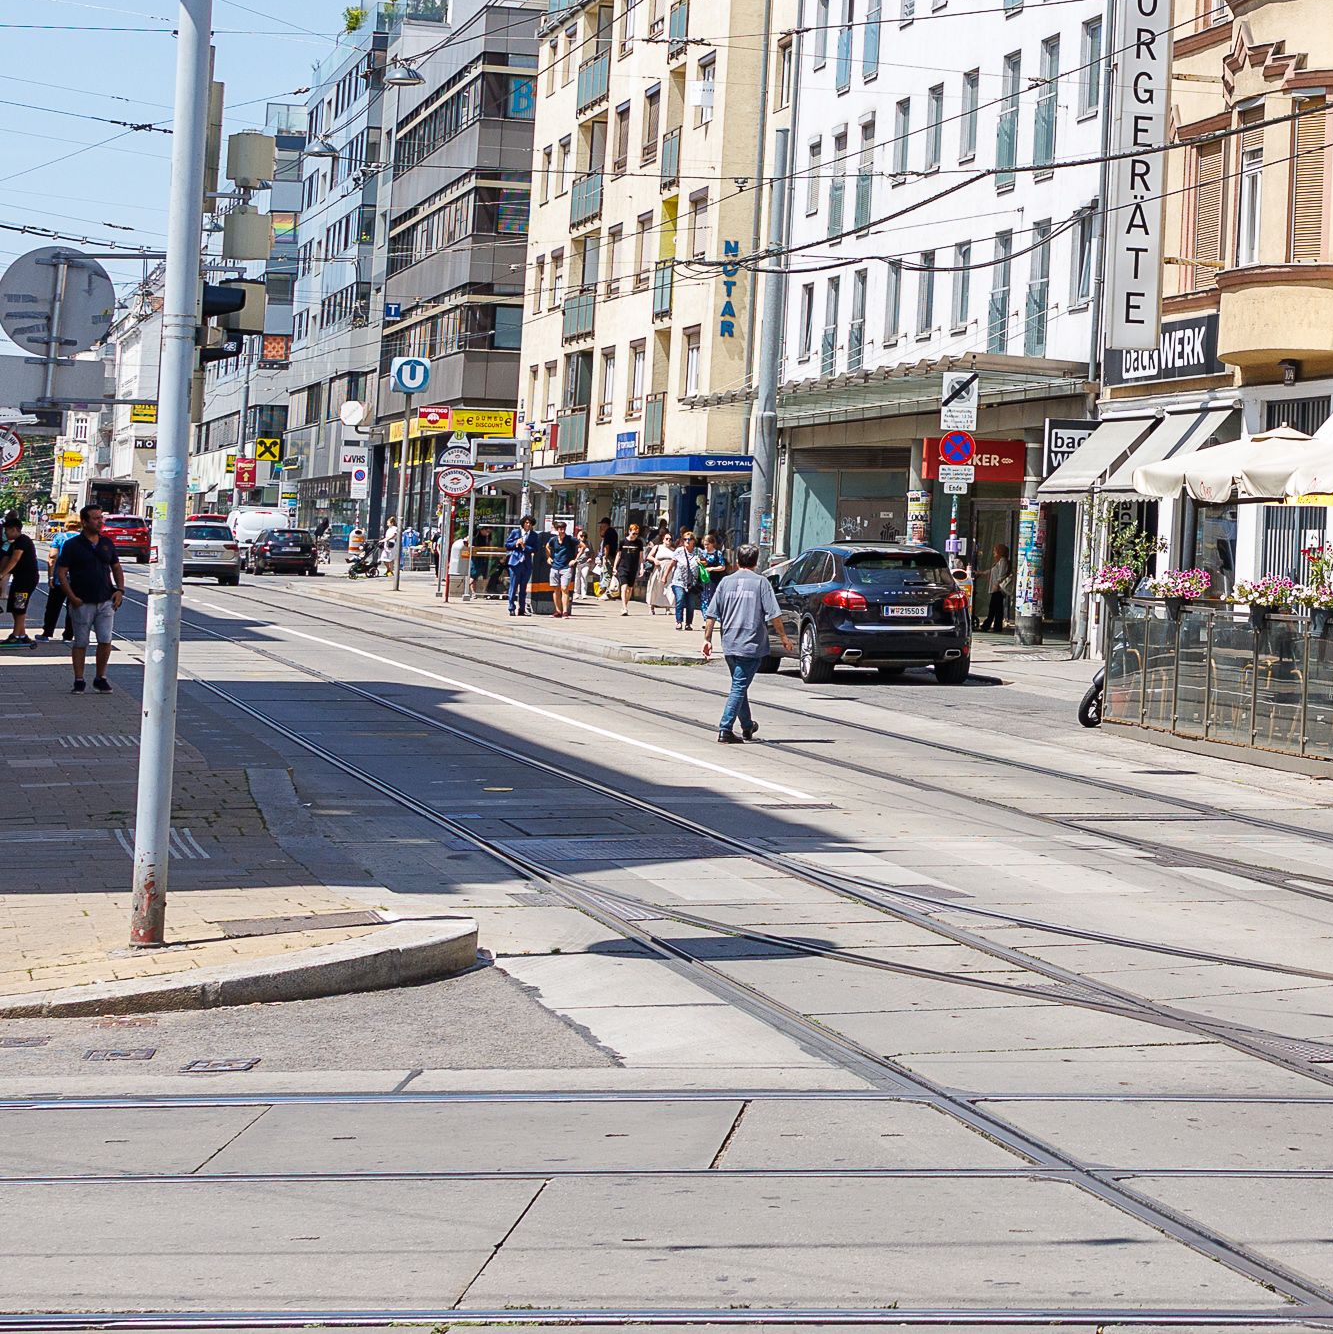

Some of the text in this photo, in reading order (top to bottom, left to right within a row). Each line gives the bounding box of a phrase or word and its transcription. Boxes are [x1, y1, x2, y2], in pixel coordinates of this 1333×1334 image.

[388, 304, 399, 315] T
[402, 365, 425, 388] U
[352, 455, 366, 464] VHS
[948, 484, 963, 492] Ende
